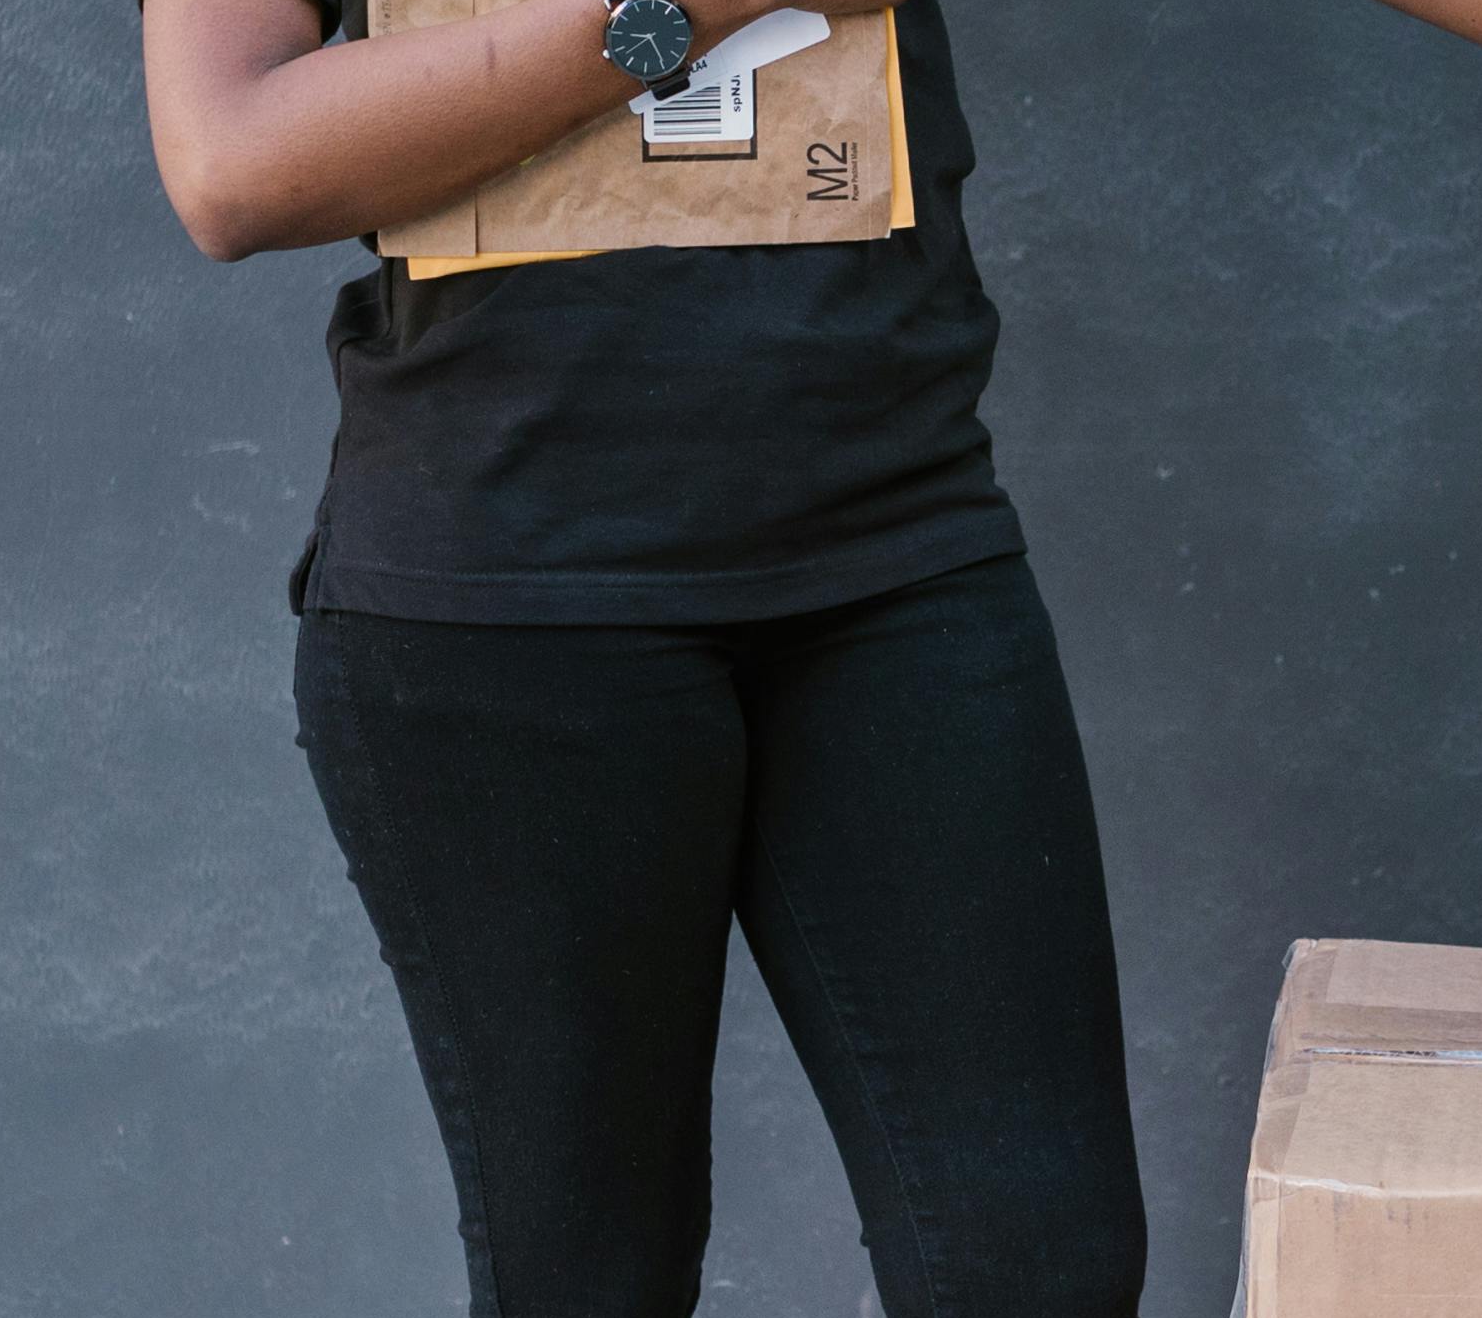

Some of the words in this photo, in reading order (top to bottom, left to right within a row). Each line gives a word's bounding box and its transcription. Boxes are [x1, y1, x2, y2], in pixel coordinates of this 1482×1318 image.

[688, 59, 708, 74] LA4
[806, 142, 848, 201] M2
[851, 183, 859, 201] Paper
